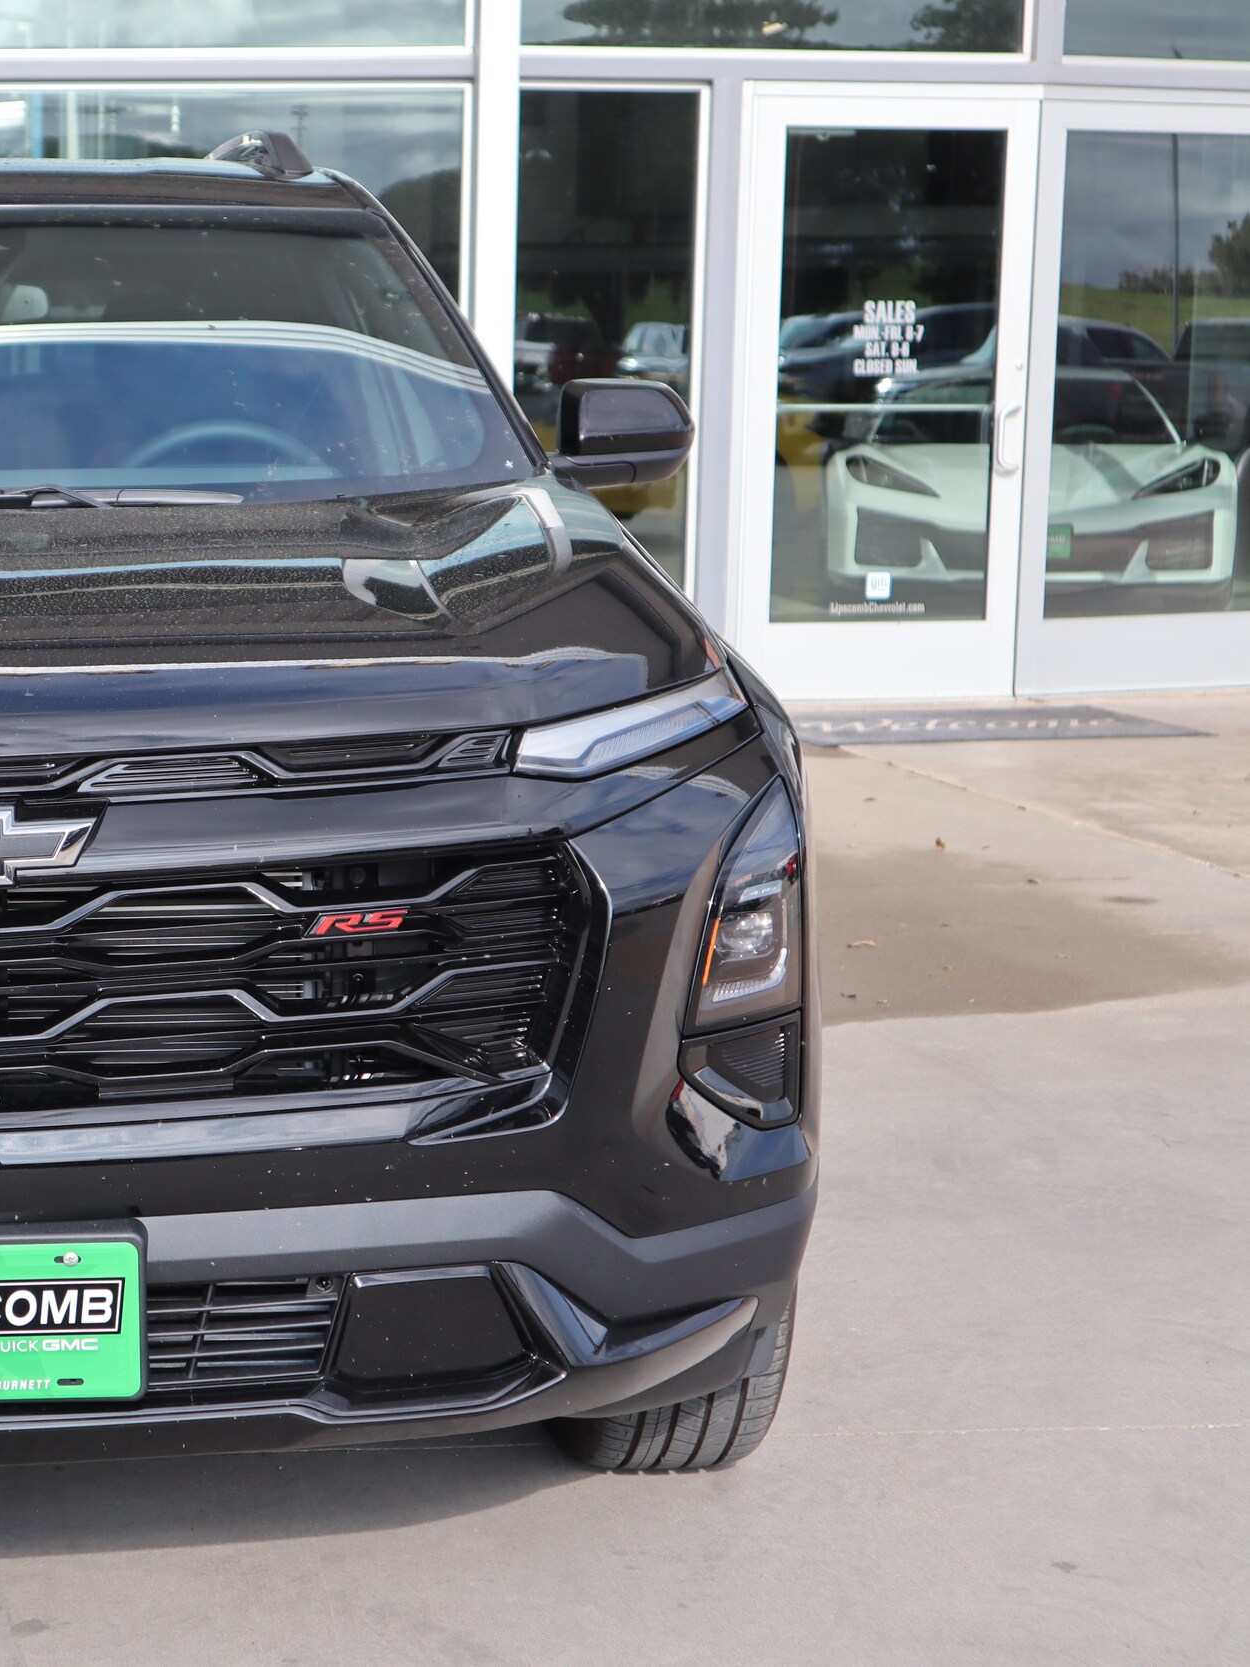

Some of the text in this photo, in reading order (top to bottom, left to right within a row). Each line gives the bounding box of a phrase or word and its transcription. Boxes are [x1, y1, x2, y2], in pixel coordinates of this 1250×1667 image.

[863, 300, 917, 324] SALES
[864, 341, 889, 357] SAT.
[853, 358, 919, 377] CLOSED SUN.
[829, 602, 925, 616] LipscombChevrolet.com
[312, 909, 408, 935] RS
[41, 1338, 99, 1351] GMC
